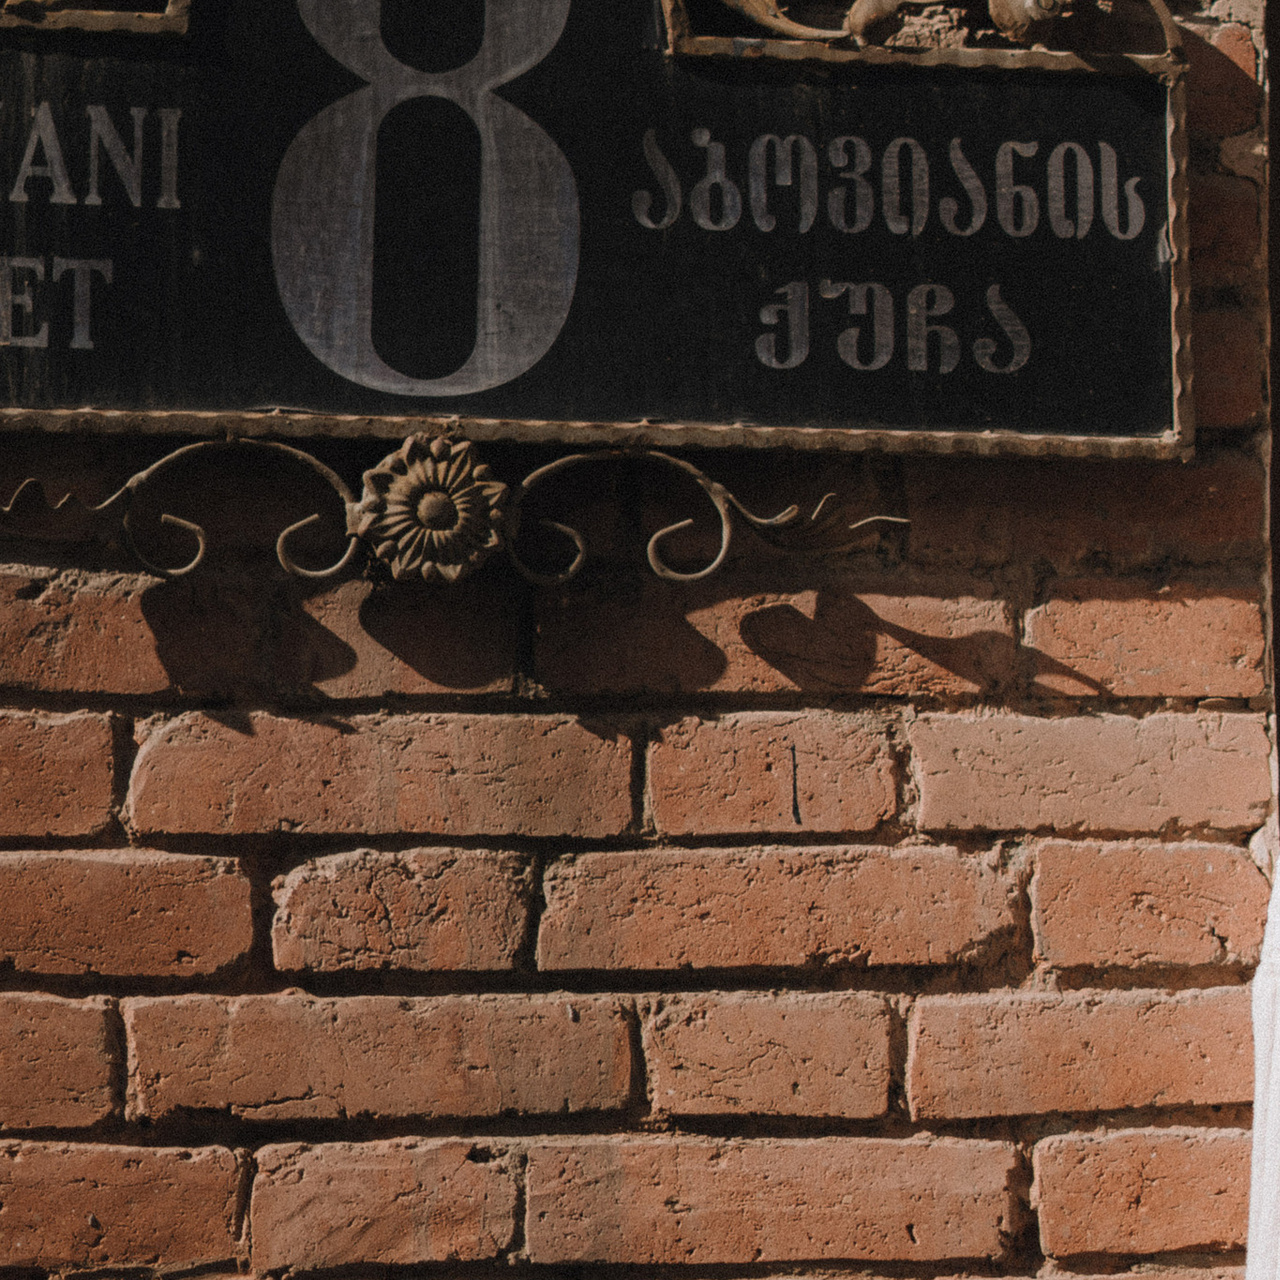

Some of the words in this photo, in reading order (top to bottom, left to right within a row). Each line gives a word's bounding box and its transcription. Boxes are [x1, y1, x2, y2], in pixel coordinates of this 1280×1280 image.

[9, 100, 182, 209] ANI
[631, 127, 1146, 240] აბოვიანის
[754, 278, 1032, 375] ქუჩა
